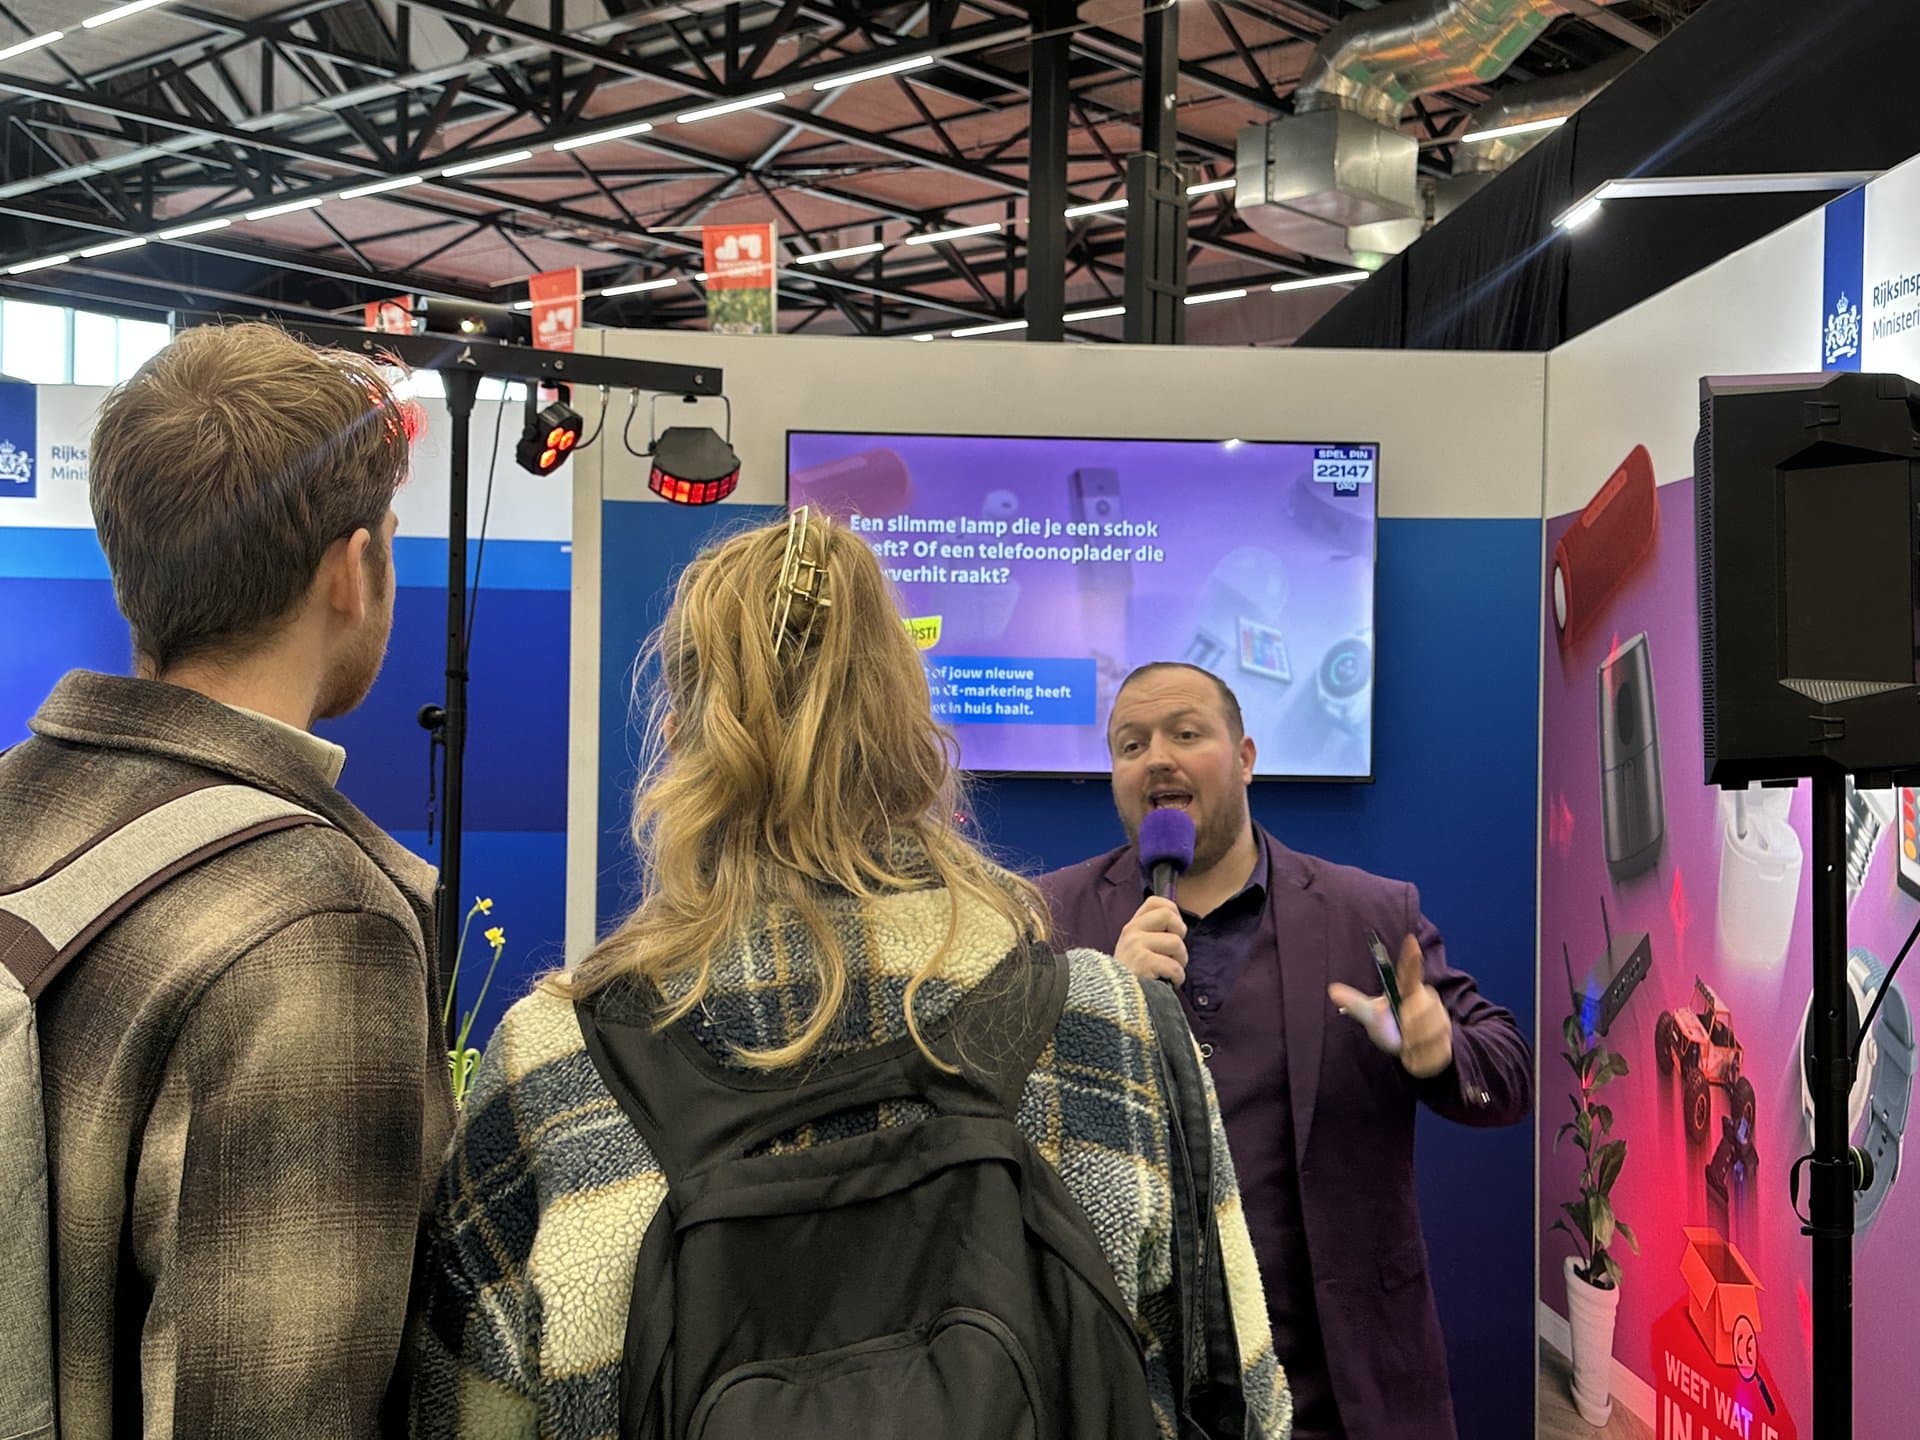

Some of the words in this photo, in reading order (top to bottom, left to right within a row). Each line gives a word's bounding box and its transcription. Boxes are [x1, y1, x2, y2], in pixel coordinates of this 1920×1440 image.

[1318, 449, 1346, 459] SPEL
[1349, 449, 1368, 459] PIN
[1317, 464, 1369, 478] 22147
[850, 514, 884, 532] Een
[887, 514, 957, 533] slimme
[960, 516, 1008, 538] lamp
[1011, 517, 1041, 535] die
[1043, 518, 1062, 539] je
[1066, 521, 1100, 536] een
[1103, 520, 1158, 537] schok
[913, 540, 938, 558] Of
[940, 543, 975, 558] een
[978, 541, 1132, 565] telefoonoplader
[1135, 545, 1164, 562] die
[950, 566, 1010, 584] raakt?
[948, 666, 983, 681] jouw
[985, 667, 1034, 680] nieuwe
[1035, 685, 1072, 698] heeft
[948, 702, 962, 714] in
[964, 702, 993, 714] huis
[995, 702, 1034, 716] haalt.
[1664, 1350, 1710, 1409] WEET
[1713, 1386, 1753, 1440] WAT
